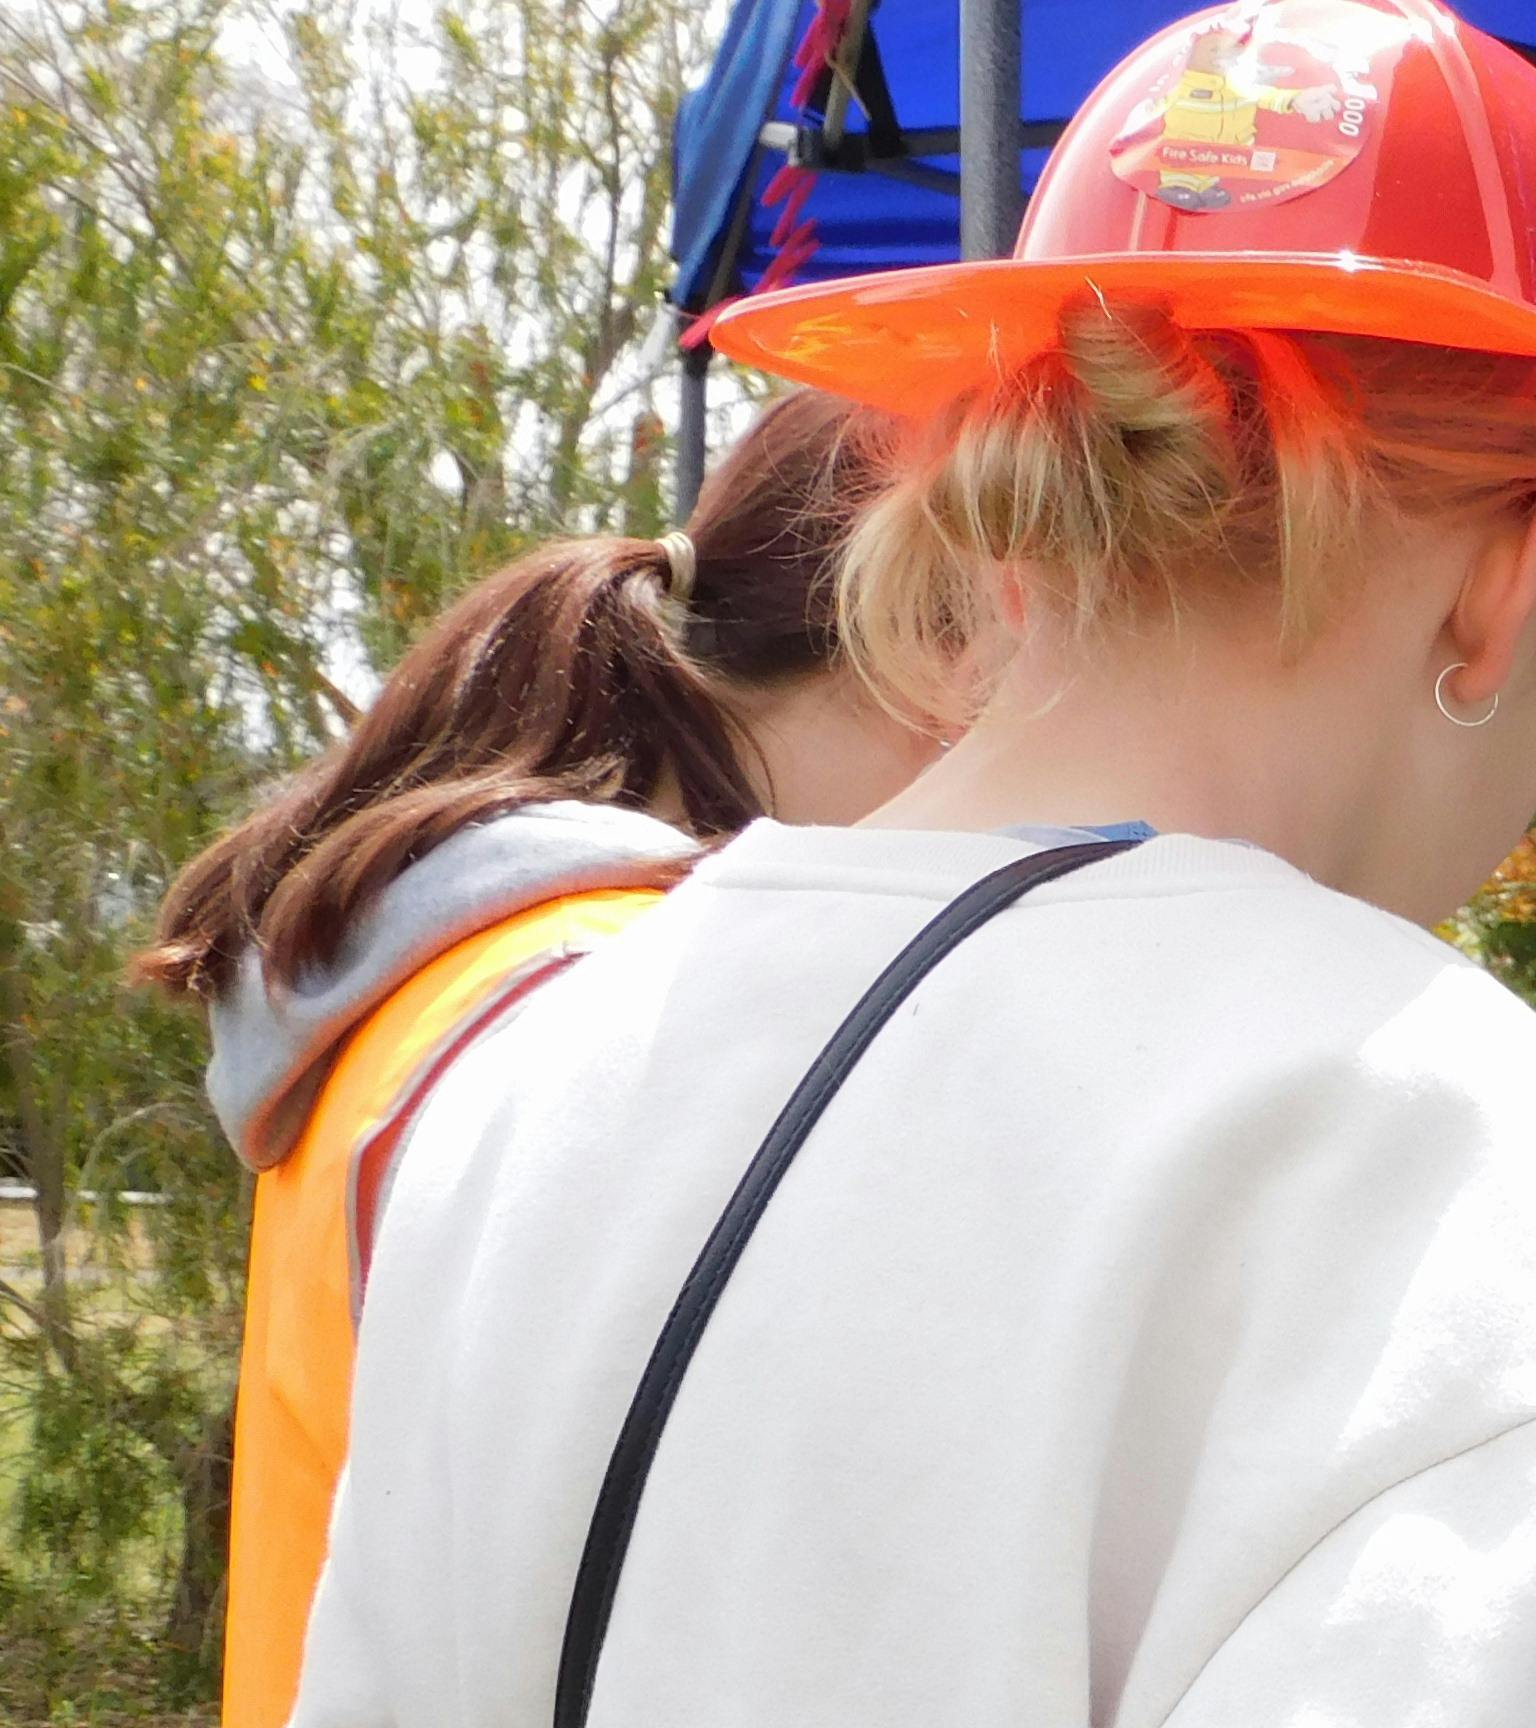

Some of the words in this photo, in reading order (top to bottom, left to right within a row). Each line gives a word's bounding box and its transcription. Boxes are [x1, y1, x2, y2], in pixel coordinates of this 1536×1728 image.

[1162, 146, 1186, 159] Fire
[1190, 148, 1218, 163] Safe
[1222, 150, 1248, 166] Kids
